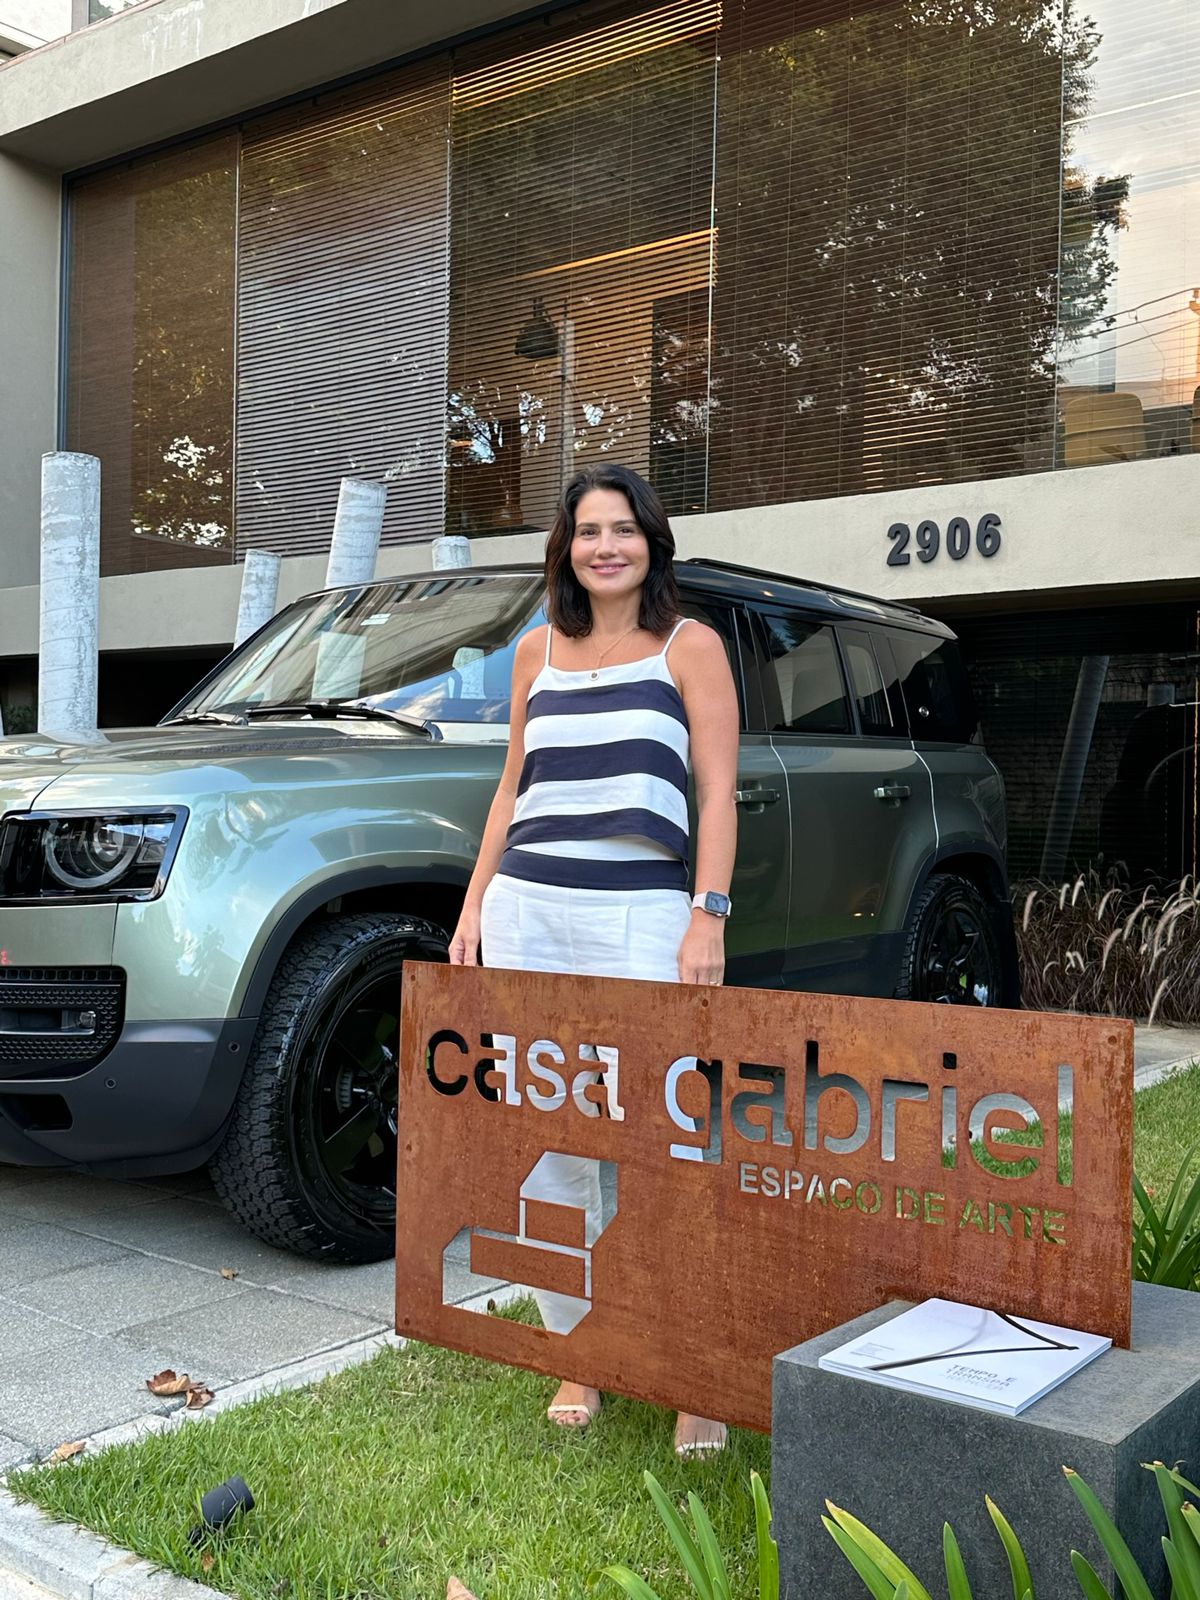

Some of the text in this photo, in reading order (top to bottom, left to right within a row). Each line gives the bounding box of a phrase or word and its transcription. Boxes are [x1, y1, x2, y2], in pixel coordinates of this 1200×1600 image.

[887, 513, 1001, 566] 2906
[426, 1029, 1074, 1187] casa gabriel
[740, 1161, 1067, 1245] ESPAÇO DE ARTE
[953, 1364, 998, 1378] TEMPO
